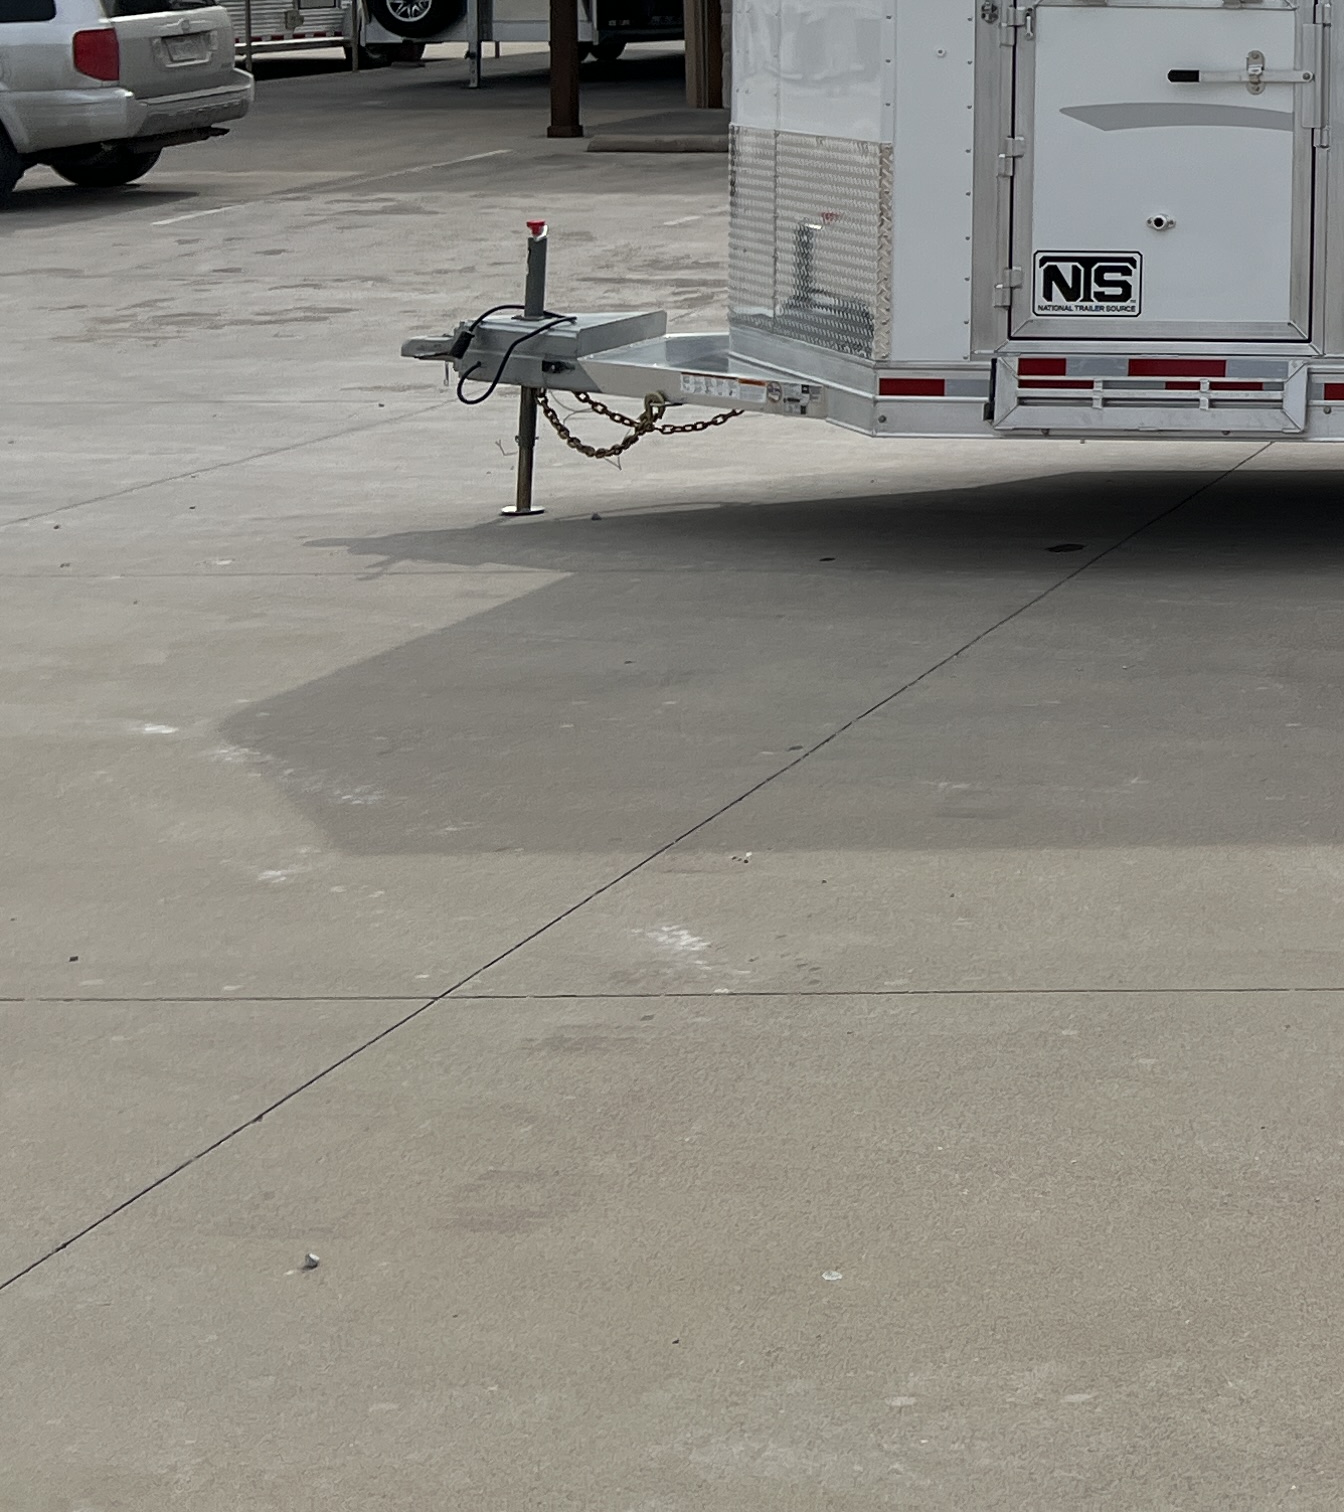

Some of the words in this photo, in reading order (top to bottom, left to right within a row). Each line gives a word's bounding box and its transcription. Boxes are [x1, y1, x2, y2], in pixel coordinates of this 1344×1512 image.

[1039, 256, 1137, 302] NTS
[1075, 305, 1105, 313] TRAILER
[1106, 305, 1137, 313] SOURCE
